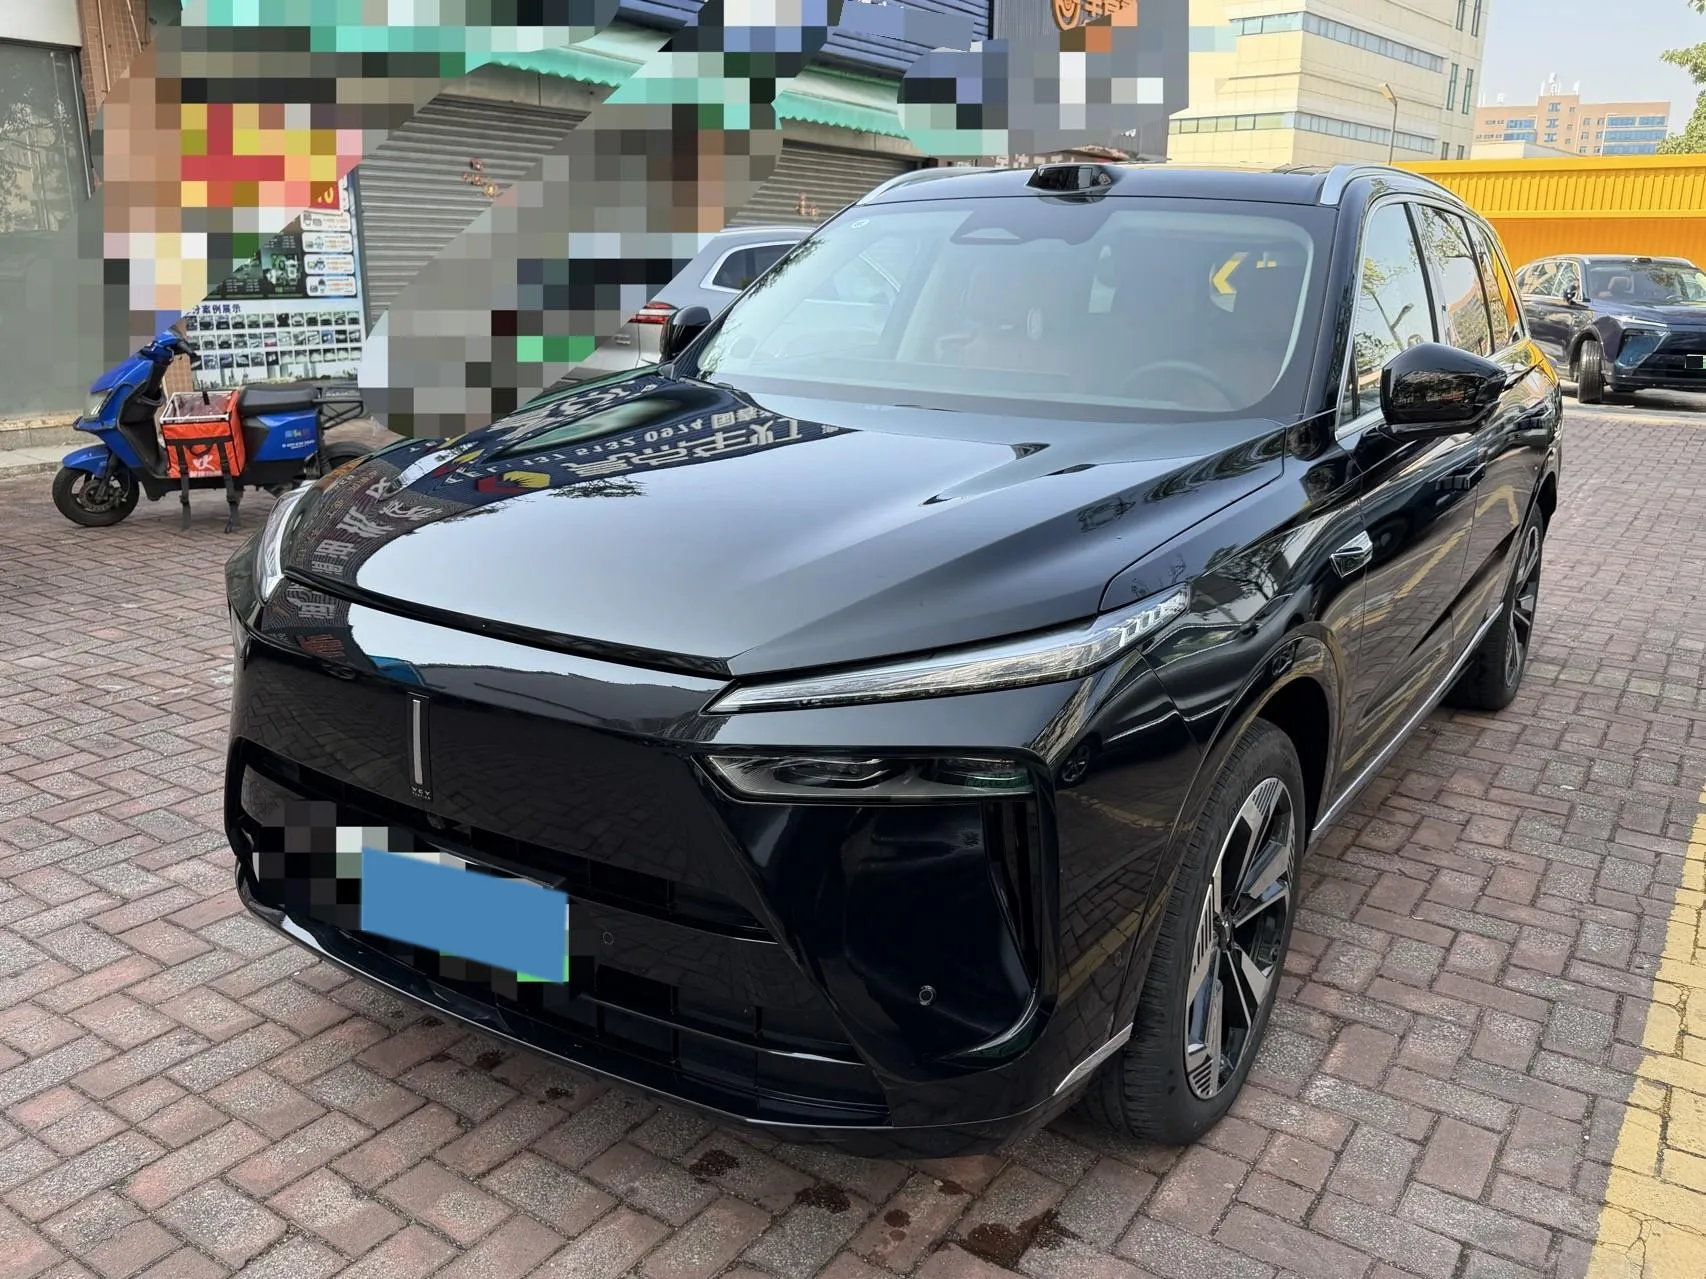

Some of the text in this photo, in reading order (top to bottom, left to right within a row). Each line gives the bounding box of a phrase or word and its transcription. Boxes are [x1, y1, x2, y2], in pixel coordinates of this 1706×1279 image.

[187, 303, 241, 315] 分案例展示
